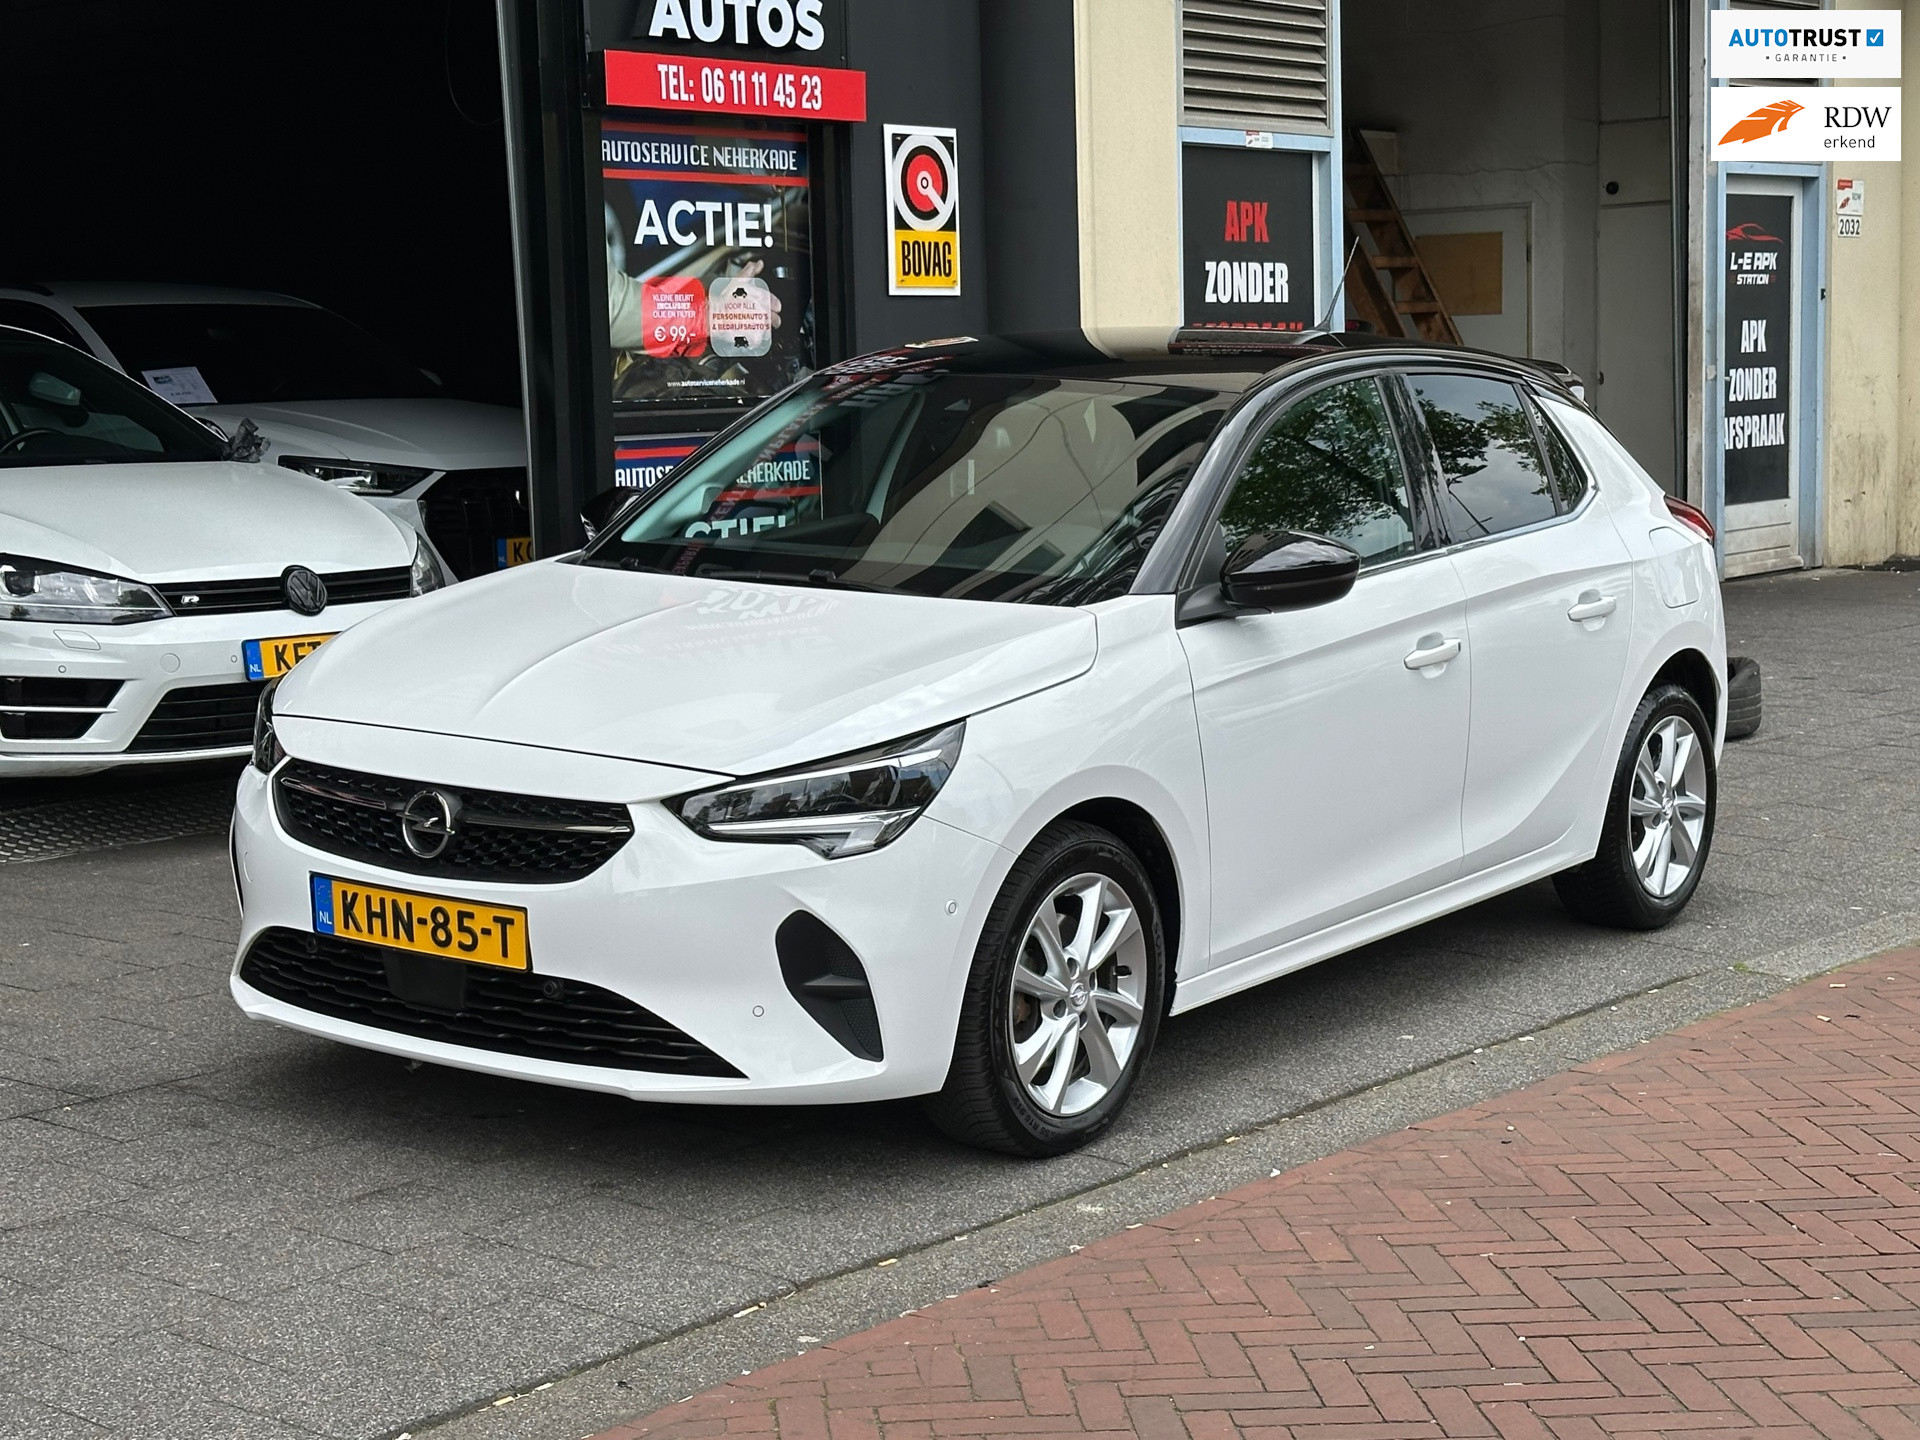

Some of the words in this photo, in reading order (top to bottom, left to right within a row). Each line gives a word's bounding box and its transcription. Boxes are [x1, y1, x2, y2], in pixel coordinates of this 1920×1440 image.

[649, 0, 825, 50] AUTOS
[657, 63, 695, 101] TEL:
[701, 67, 725, 104] 06
[729, 70, 746, 105] 11
[751, 72, 768, 106] 11
[773, 73, 796, 109] 45
[801, 75, 822, 110] 23
[601, 139, 709, 166] AUTOSERVICE
[713, 146, 797, 171] NEHERKADE
[633, 199, 774, 249] ACTIE!
[1224, 200, 1269, 243] APK
[1839, 219, 1860, 235] 2032
[901, 240, 952, 278] BOVAG
[1753, 252, 1778, 271] APK
[1204, 261, 1289, 304] ZONDER
[1736, 274, 1769, 285] STATION
[652, 294, 673, 302] KLEINE
[654, 326, 667, 341] €
[669, 325, 696, 343] 99,-
[1740, 319, 1767, 353] APK
[1728, 366, 1777, 402] ZONDER
[1724, 412, 1785, 450] AFSPRAAK
[736, 460, 811, 484] EHERKADE
[249, 664, 261, 673] NL
[319, 911, 332, 925] NL
[340, 889, 515, 959] KHN-85-T
